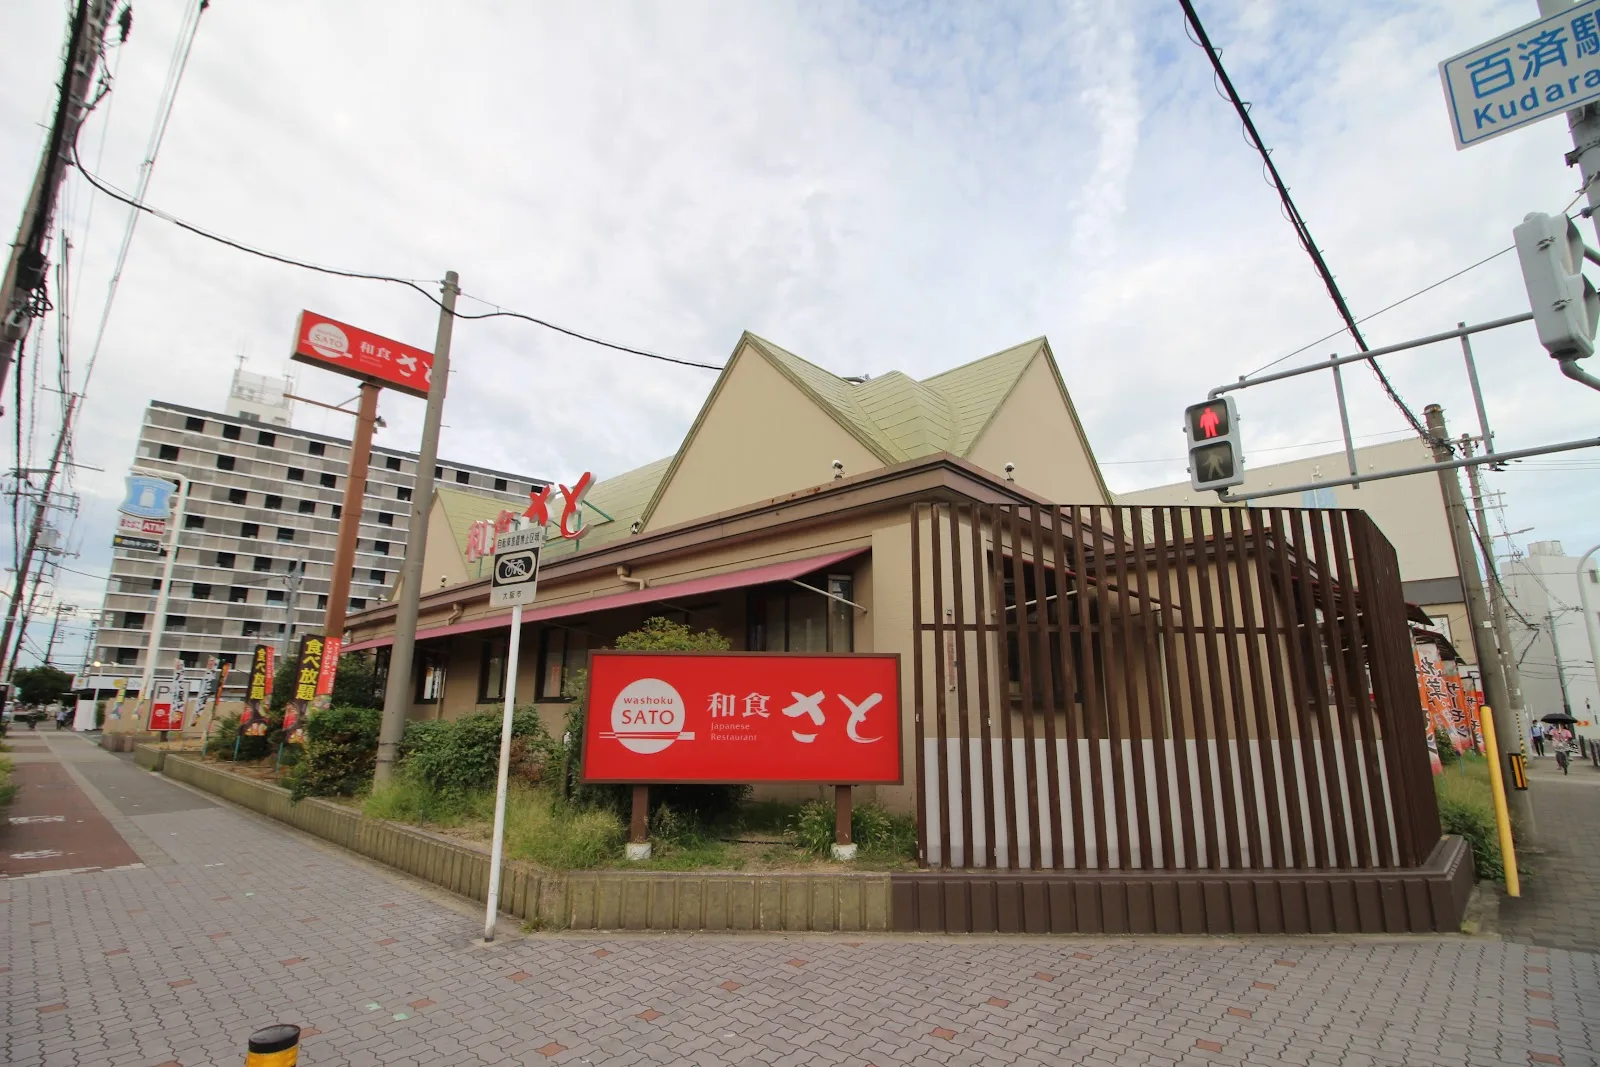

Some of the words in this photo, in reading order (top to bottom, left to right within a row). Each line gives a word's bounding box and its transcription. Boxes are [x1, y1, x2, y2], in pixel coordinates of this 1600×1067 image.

[314, 333, 343, 348] SATO
[143, 522, 165, 533] ATM
[502, 590, 522, 600] 大阪市
[250, 648, 266, 699] 食べ放題
[296, 638, 323, 701] 食べ放題
[156, 685, 170, 699] P
[623, 695, 673, 705] washoku
[621, 709, 674, 725] SATO
[711, 722, 750, 731] Japanese
[711, 733, 757, 741] Restaurant
